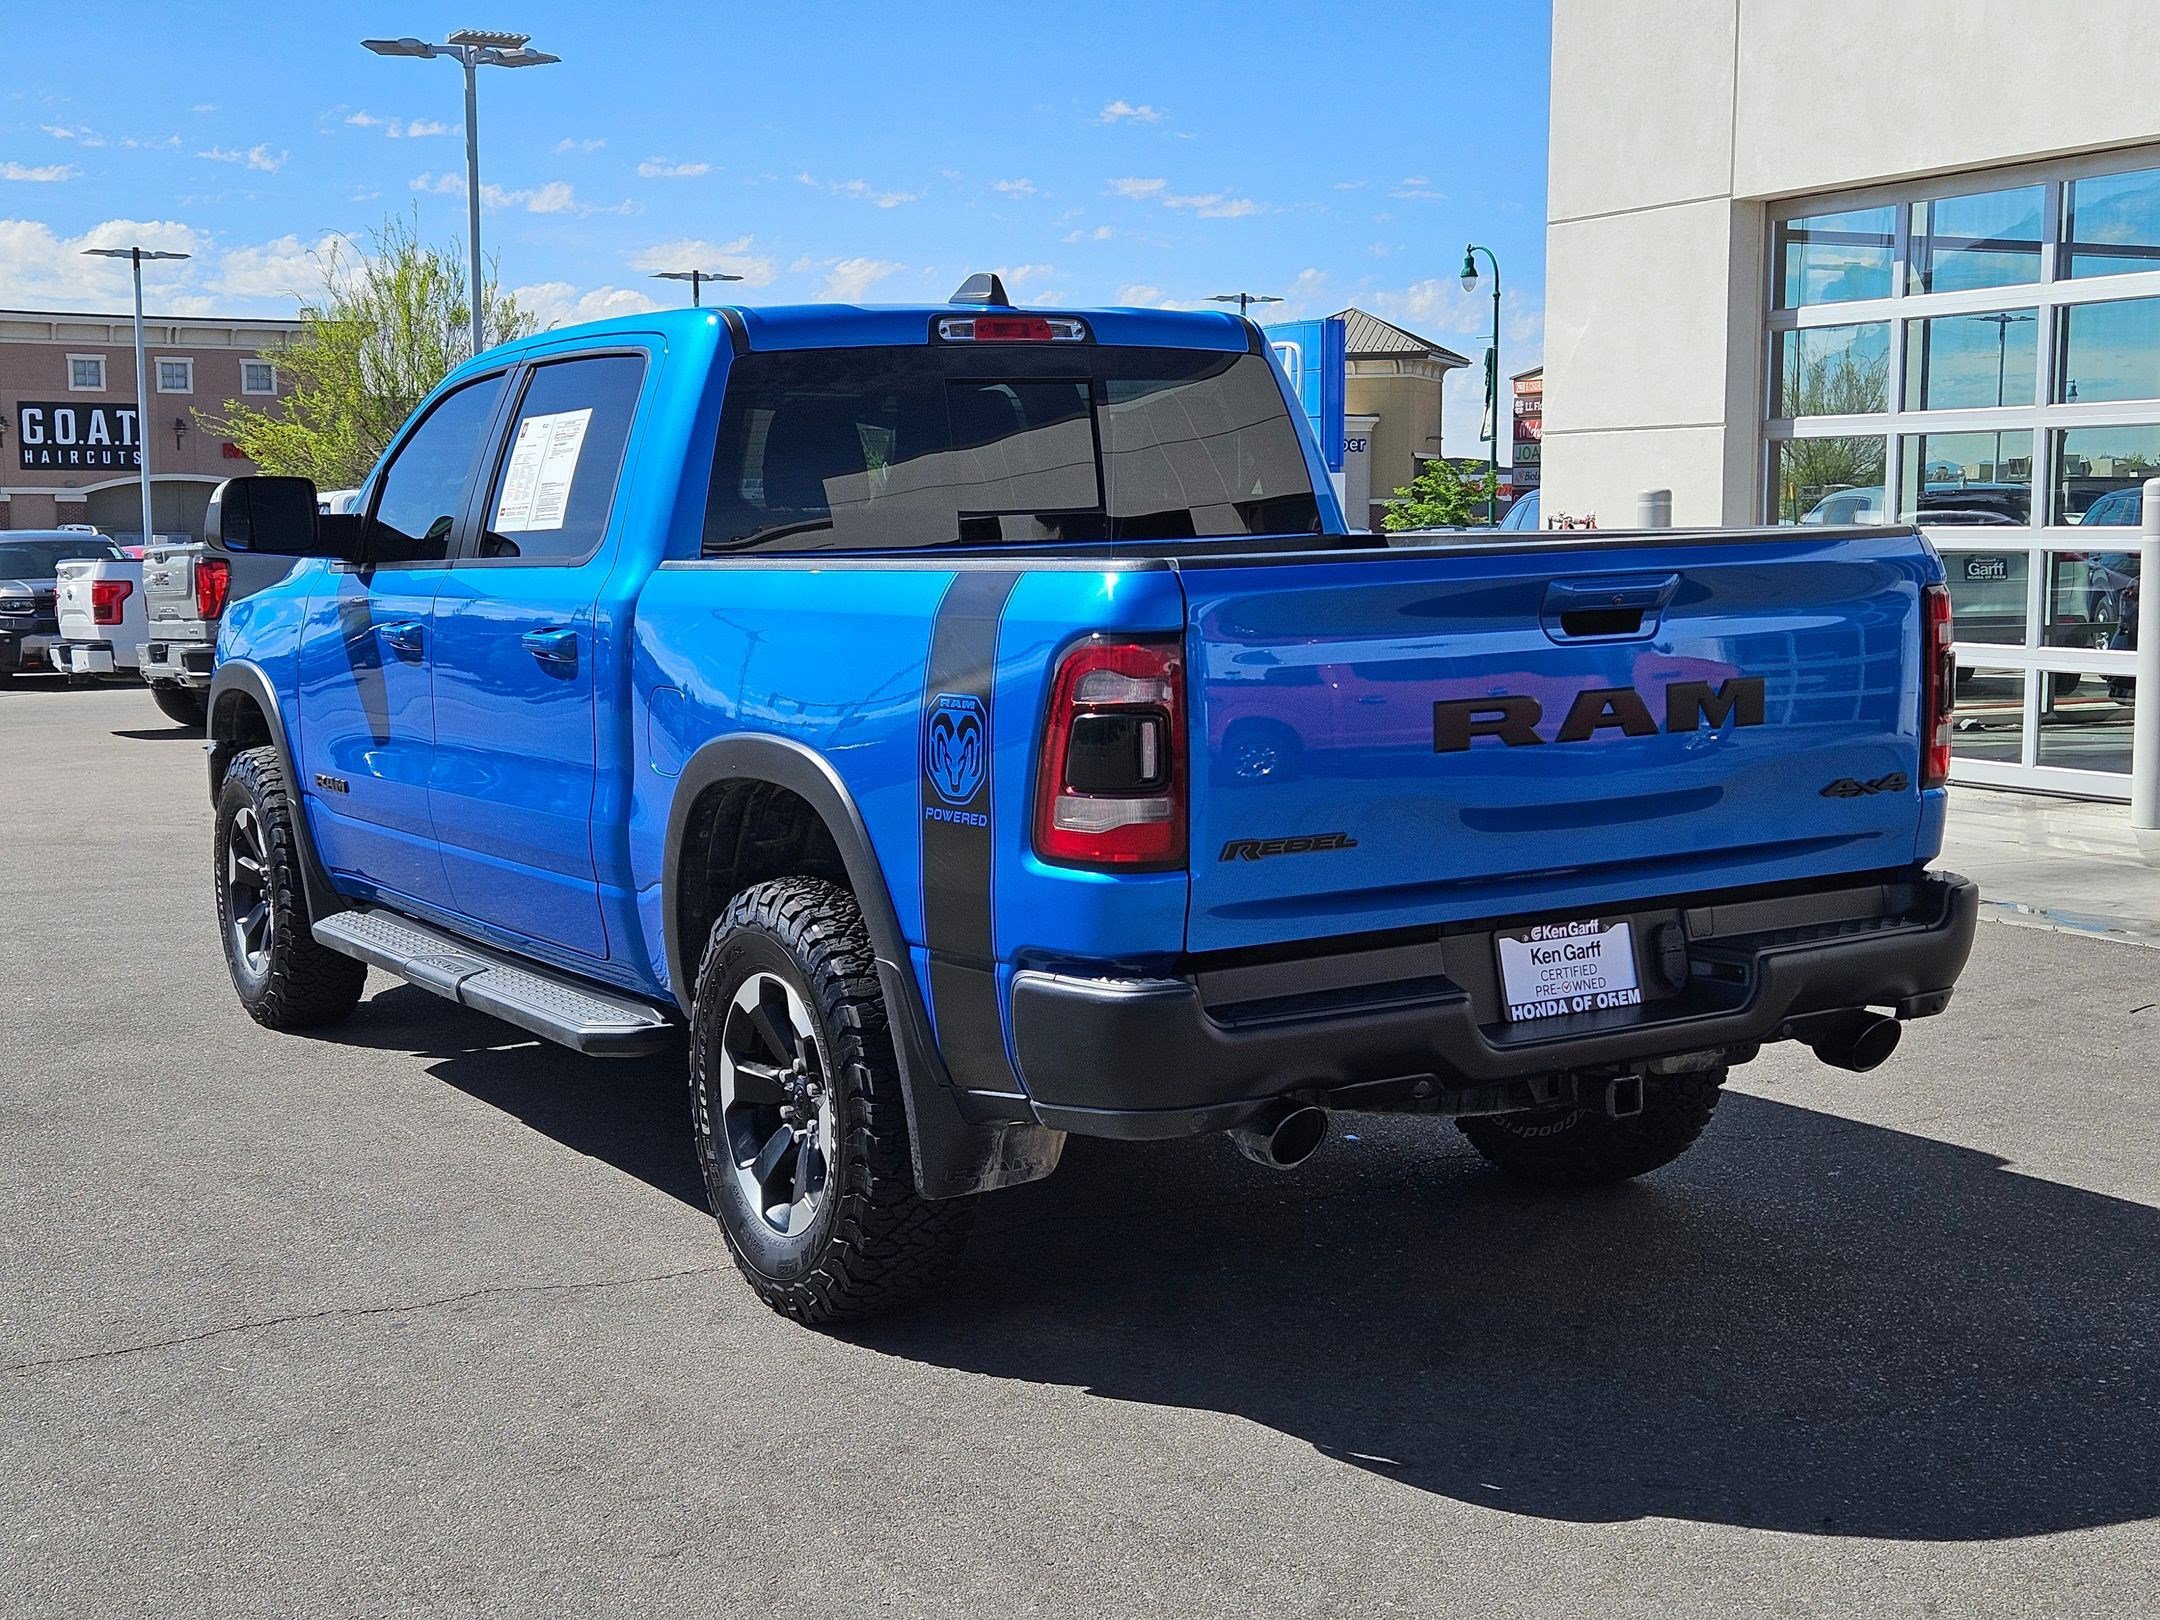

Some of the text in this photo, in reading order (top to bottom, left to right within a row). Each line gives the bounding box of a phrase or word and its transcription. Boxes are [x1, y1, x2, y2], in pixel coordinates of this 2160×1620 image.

[21, 408, 140, 445] G.O.A.T.
[24, 449, 141, 465] HAIRCUTS
[1968, 562, 2004, 576] Garff
[940, 698, 976, 710] RAM
[1432, 676, 1766, 754] RAM
[314, 773, 350, 794] RAM
[925, 807, 988, 827] POWERED
[1219, 832, 1358, 863] REBEL
[1542, 919, 1599, 939] Ken Garff
[1530, 940, 1602, 966] Ken Garff
[1540, 963, 1598, 982] CERTIFIED
[1511, 988, 1642, 1022] HONDA OF OREM
